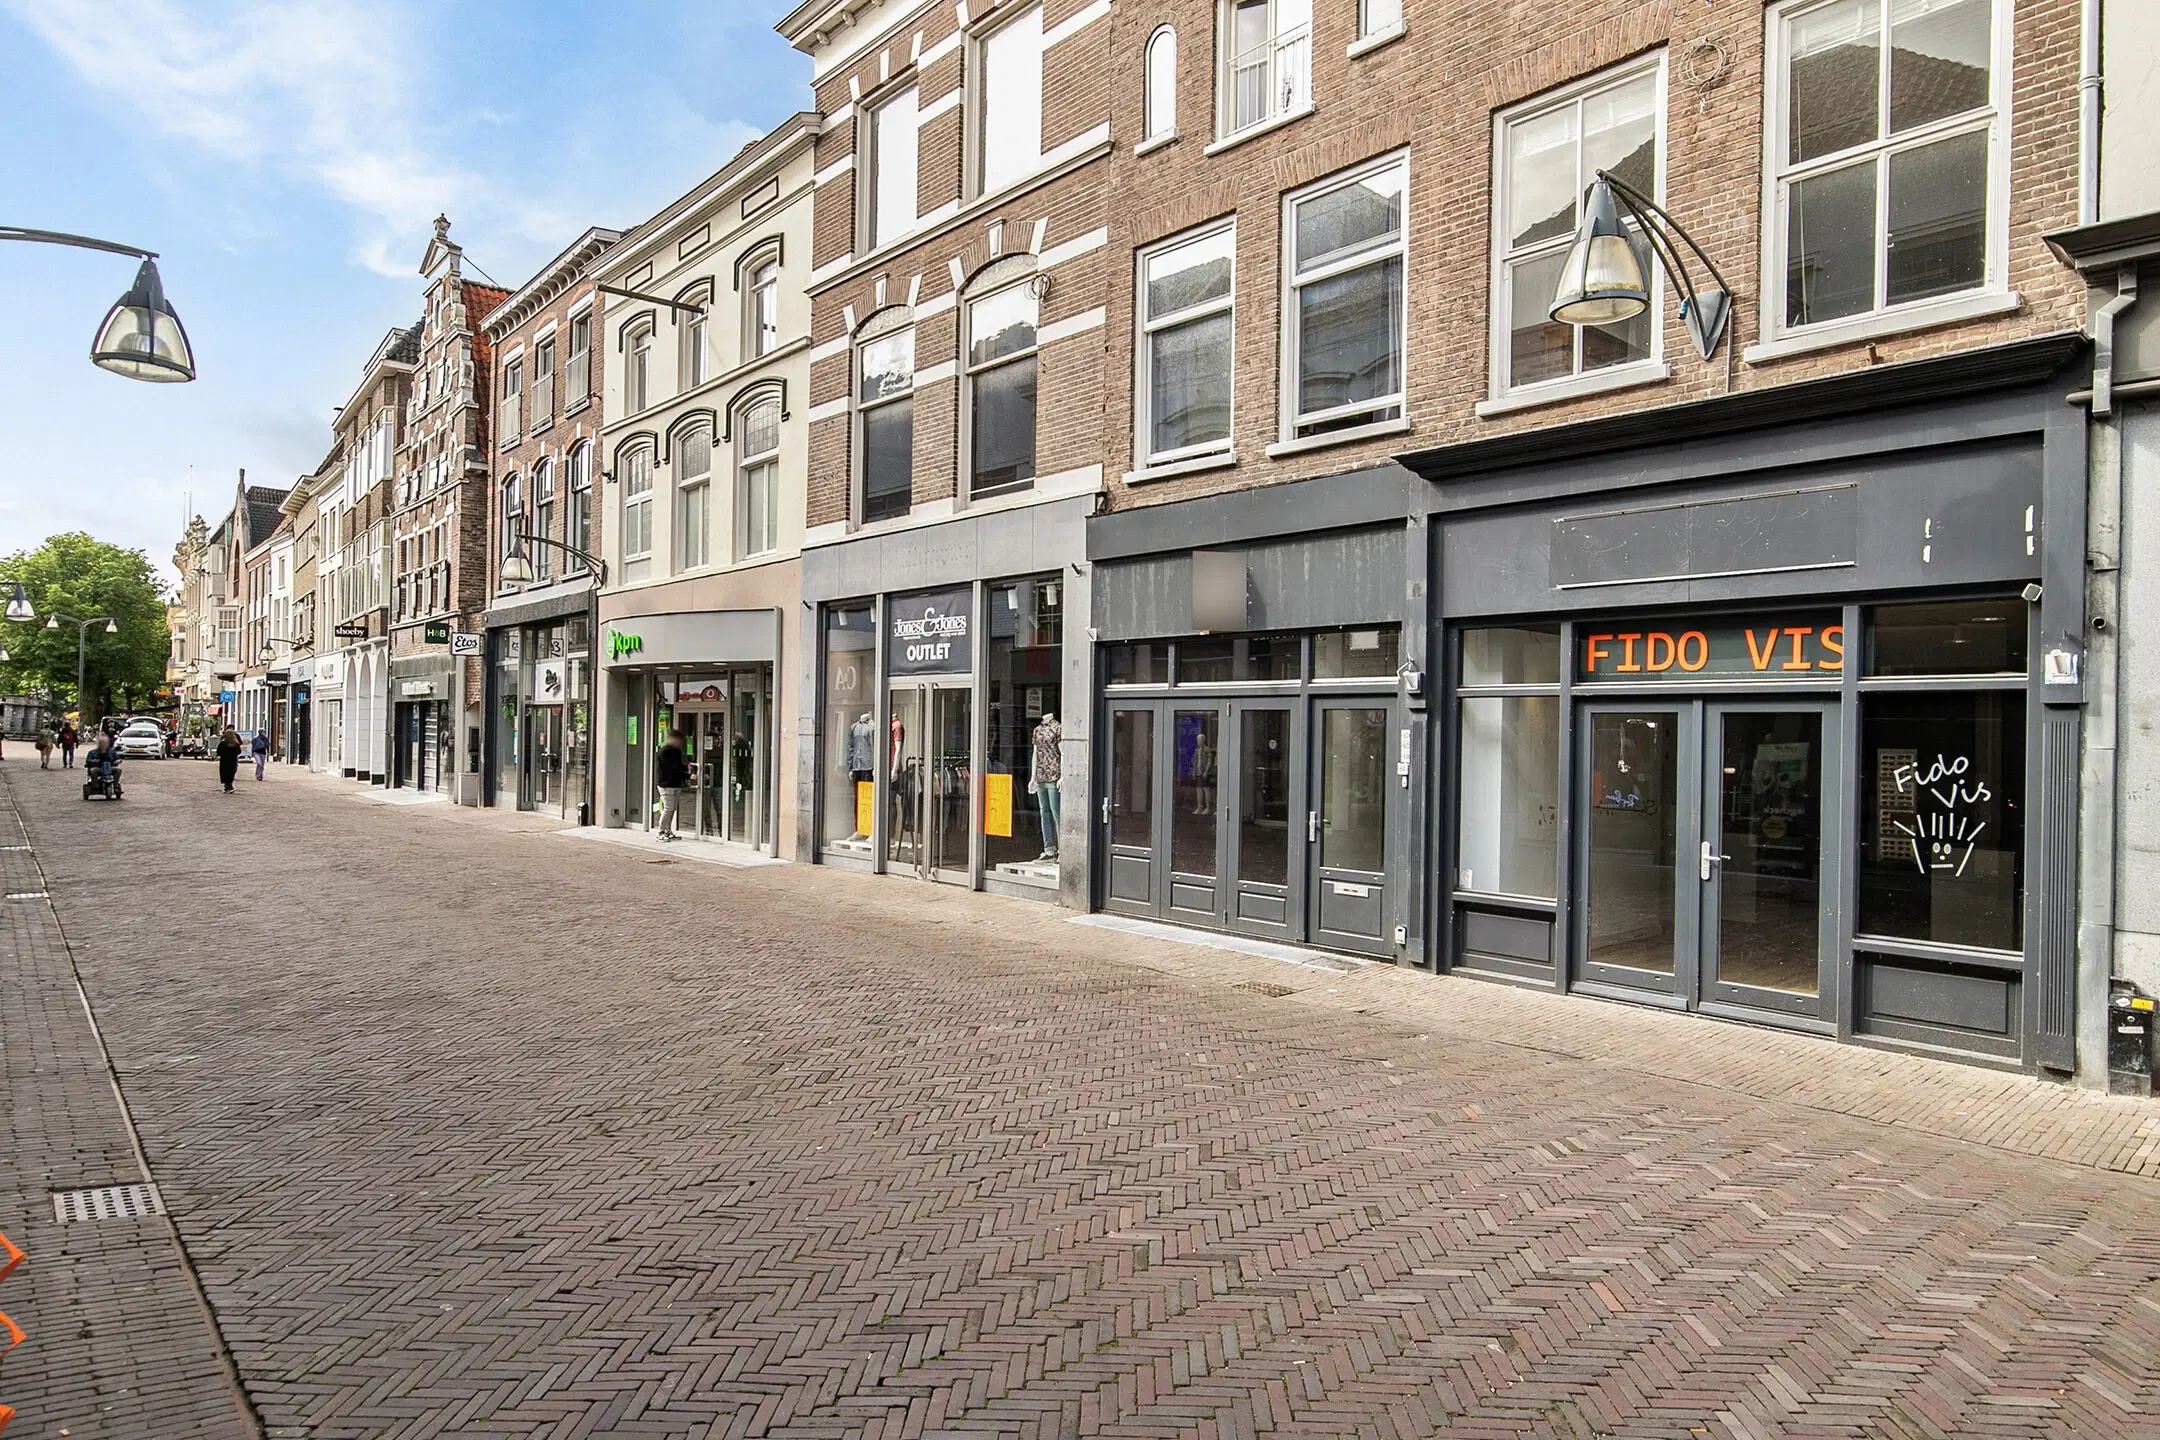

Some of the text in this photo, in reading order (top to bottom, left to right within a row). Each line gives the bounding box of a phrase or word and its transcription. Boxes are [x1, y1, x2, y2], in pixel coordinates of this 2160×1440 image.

[335, 626, 365, 637] shoeby
[893, 619, 921, 635] Jones
[937, 614, 967, 632] Jones
[455, 635, 478, 649] Etos
[615, 632, 641, 655] kpn
[906, 643, 951, 661] OUTLET
[1587, 625, 1843, 672] FIDO VIS
[1893, 753, 1969, 793] Fido
[1930, 779, 1992, 809] Vis
